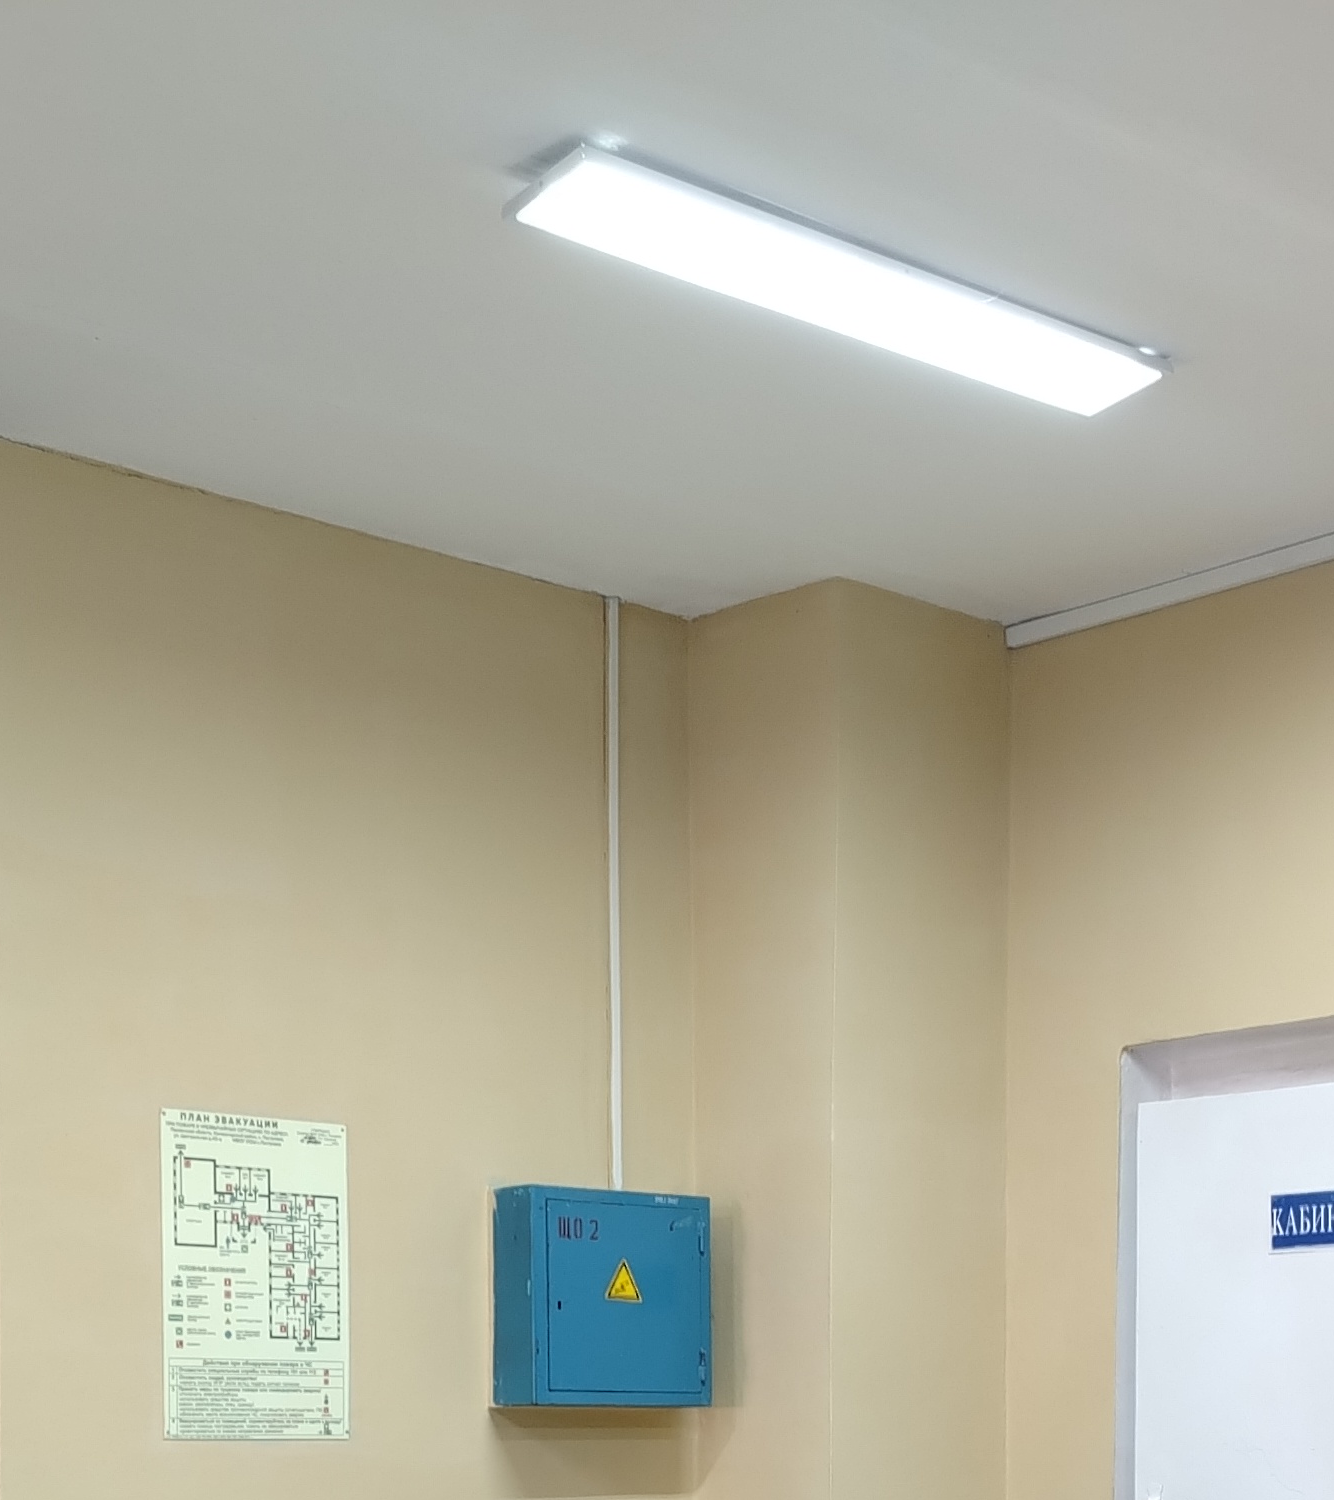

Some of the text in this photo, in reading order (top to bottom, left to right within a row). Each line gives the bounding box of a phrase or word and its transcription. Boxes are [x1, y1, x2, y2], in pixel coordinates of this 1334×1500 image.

[180, 1112, 210, 1123] ПЛАН
[215, 1115, 279, 1129] ЭВАКУАЦИИ
[589, 1219, 599, 1241] 2
